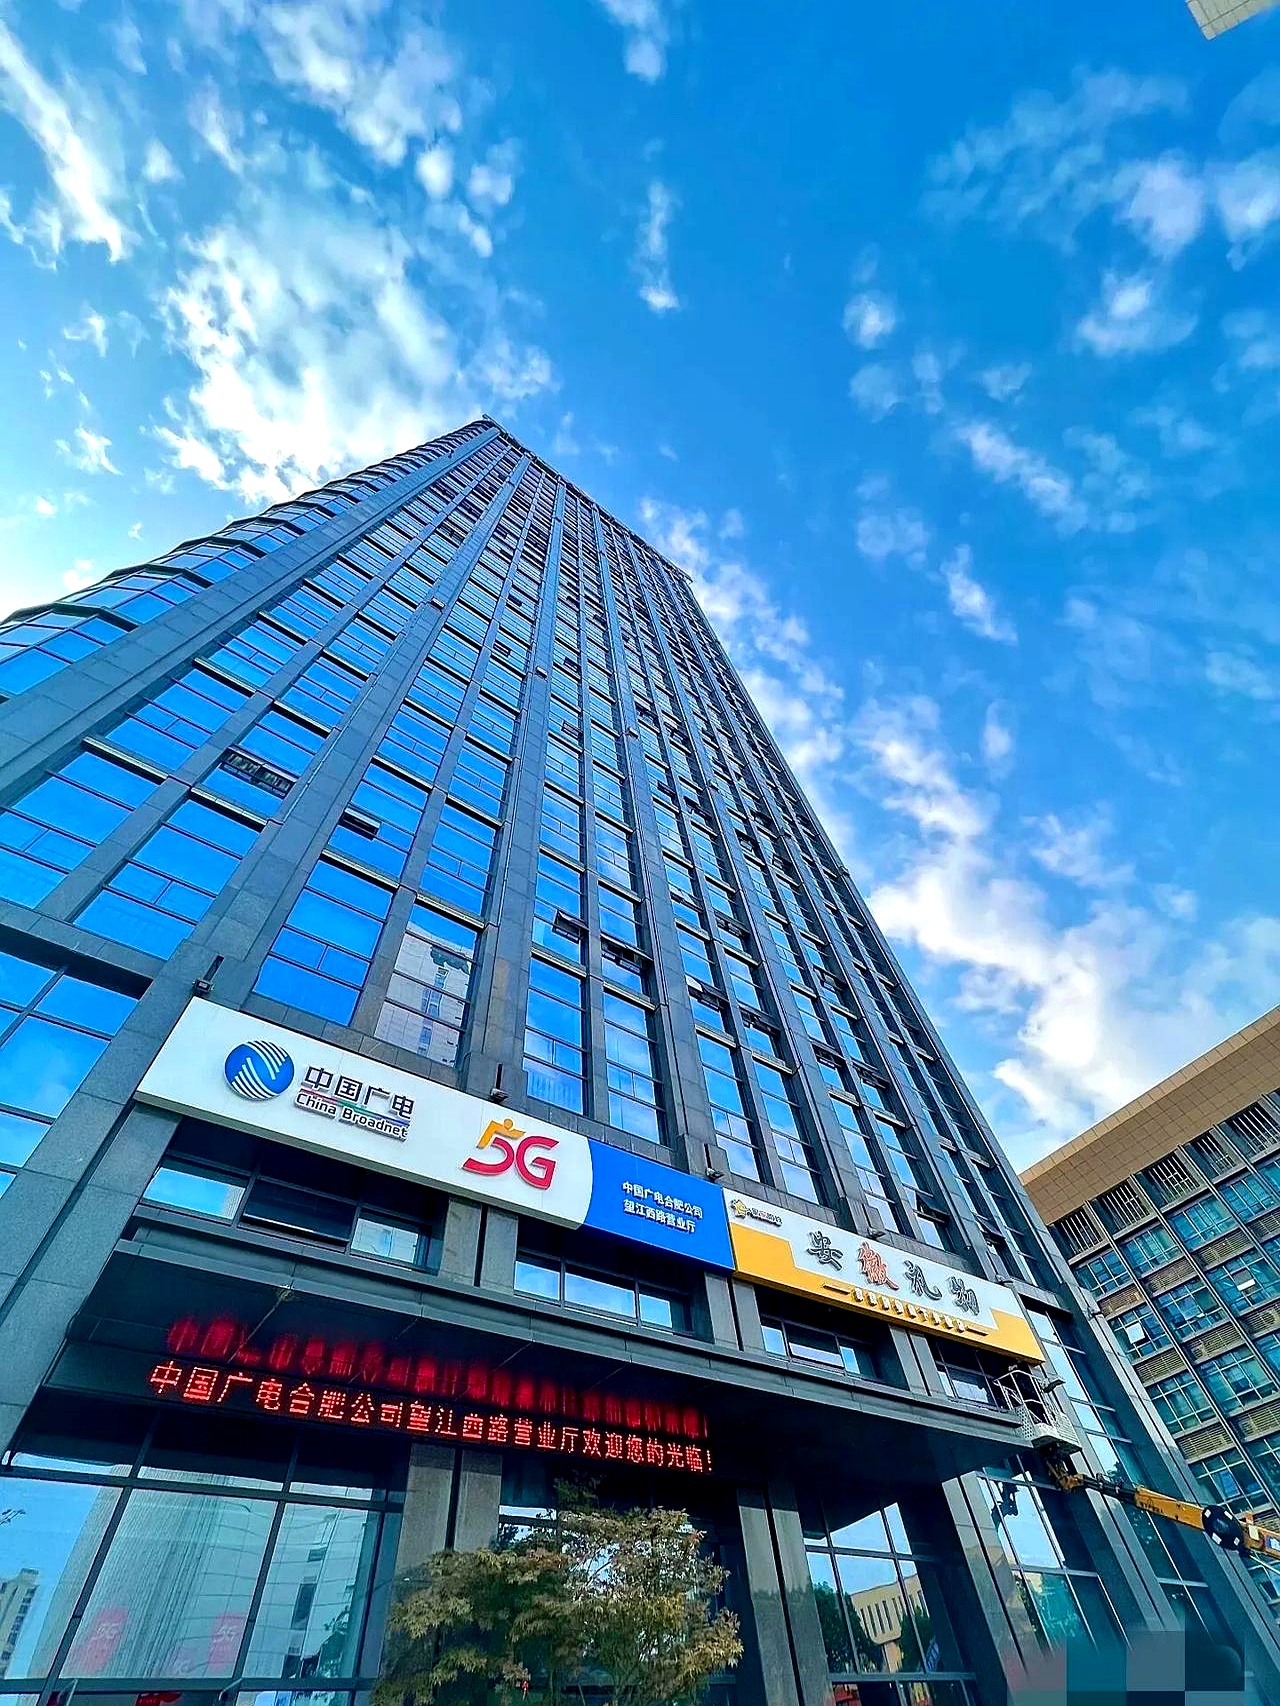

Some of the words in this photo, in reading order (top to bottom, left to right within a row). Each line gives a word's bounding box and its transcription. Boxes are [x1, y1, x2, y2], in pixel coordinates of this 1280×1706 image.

[304, 1066, 415, 1119] 中国广电
[296, 1093, 337, 1115] China
[342, 1108, 407, 1138] Broadnet
[462, 1119, 560, 1190] 5G
[622, 1181, 703, 1219] 中国广电合肥公司
[623, 1199, 696, 1233] 望江西路营业厅
